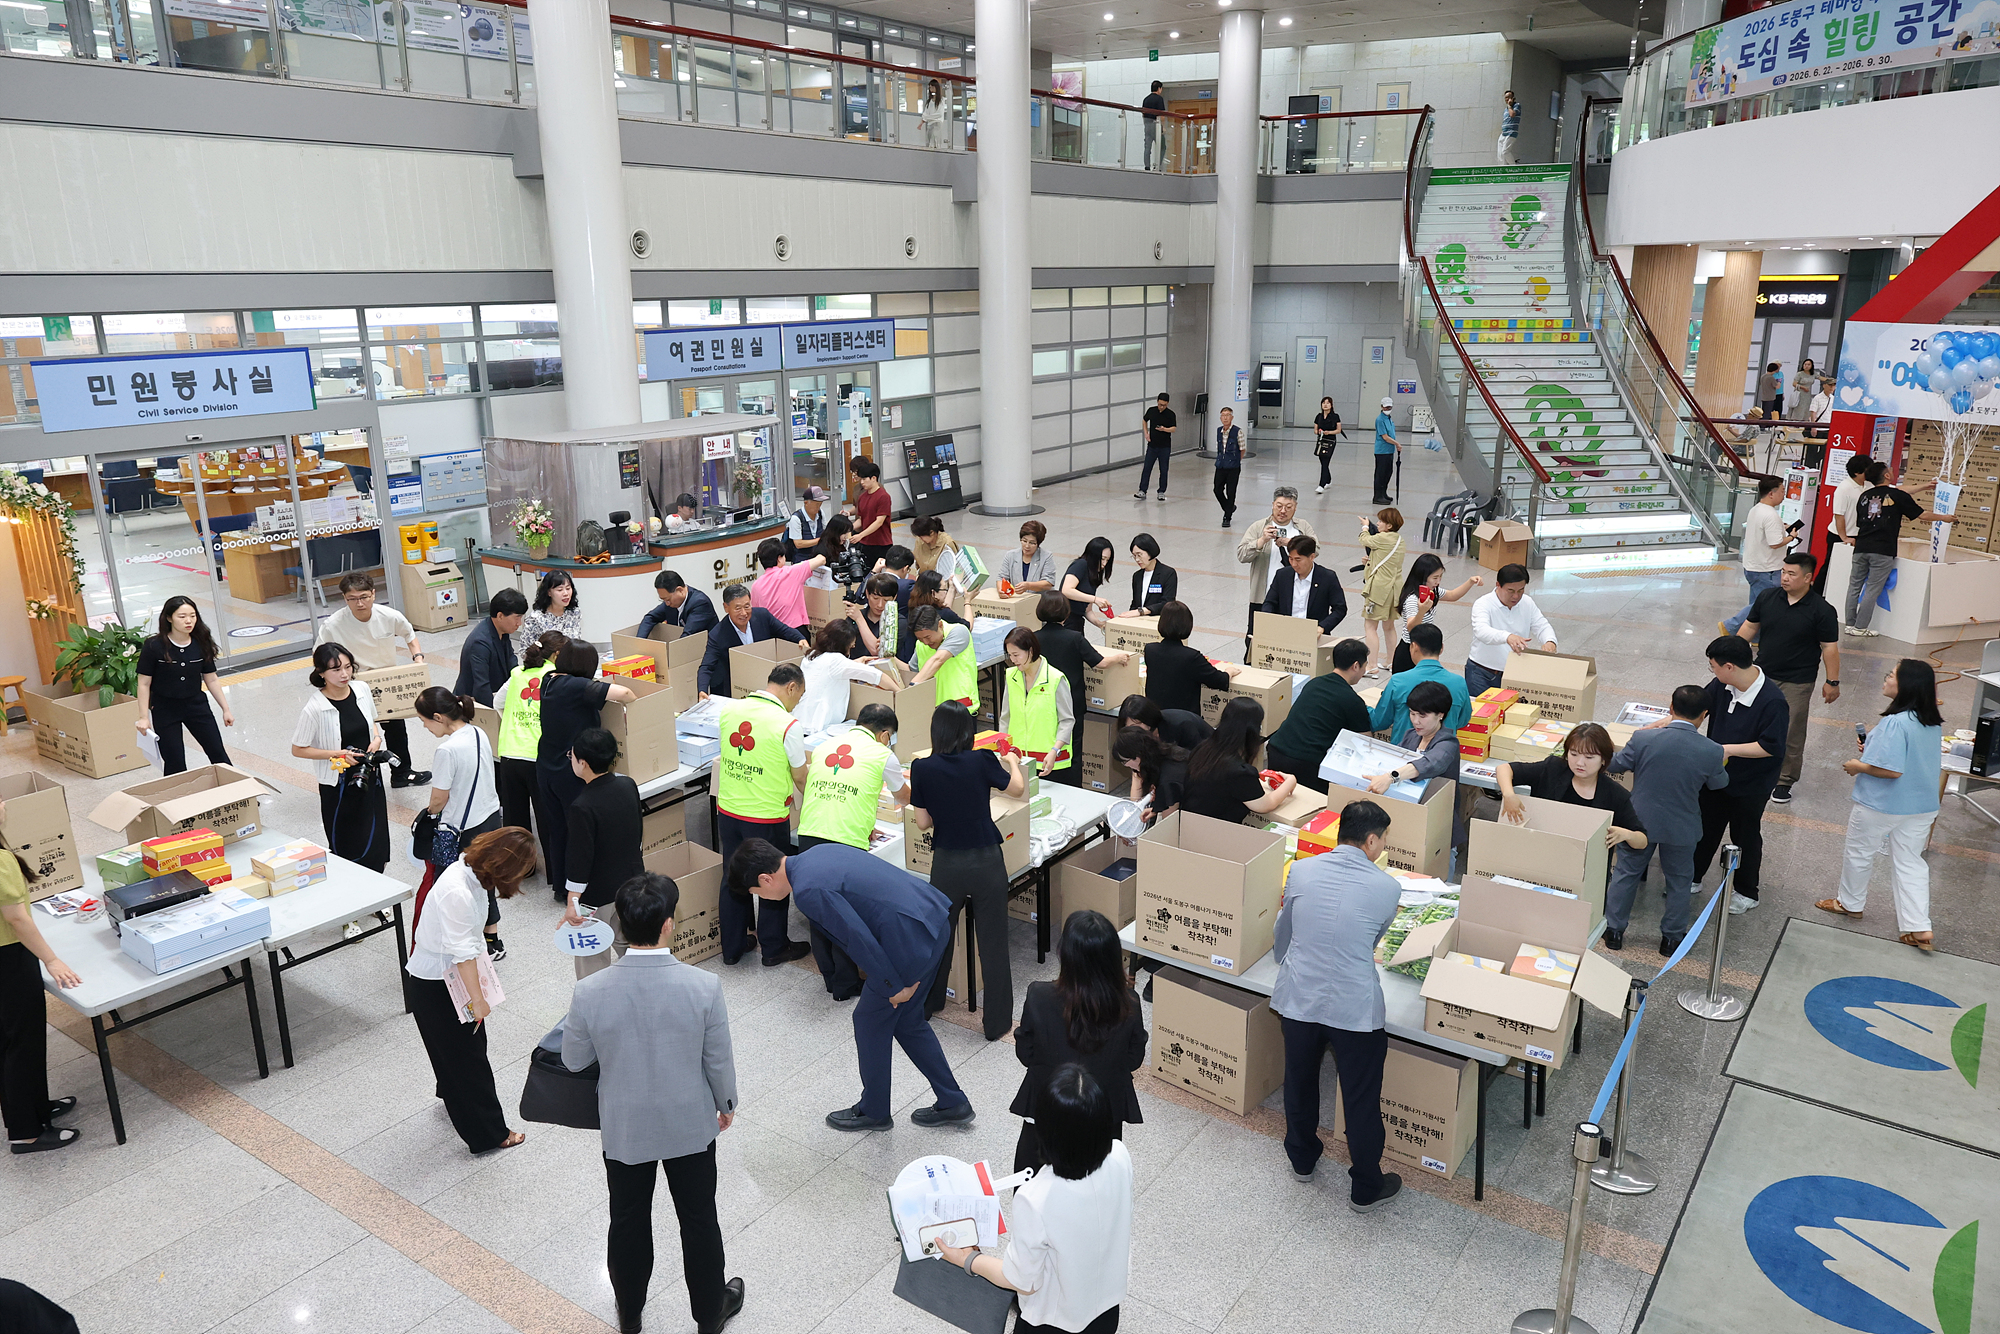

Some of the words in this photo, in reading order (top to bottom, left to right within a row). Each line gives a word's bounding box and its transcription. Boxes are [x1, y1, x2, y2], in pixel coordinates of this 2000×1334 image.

[1744, 14, 1775, 37] 2026
[1778, 5, 1815, 28] 도봉구
[1737, 35, 1780, 74] 도심
[1787, 27, 1811, 64] 속
[1824, 10, 1880, 59] 힐링
[1894, 0, 1965, 45] 공간
[1789, 71, 1811, 82] 2026.
[1813, 70, 1821, 78] 6.
[1867, 58, 1875, 67] 9.
[1878, 55, 1893, 65] 30.
[1769, 294, 1788, 304] KB
[669, 336, 763, 363] 여권민원실
[795, 329, 886, 354] 일자리플러스센터
[842, 354, 856, 362] Support
[691, 364, 713, 374] Passport
[714, 363, 747, 373] Consultations
[87, 365, 274, 407] 민원봉사실
[138, 409, 160, 418] Civil
[163, 406, 199, 416] Service
[202, 402, 239, 413] Division
[1975, 406, 1998, 415] 도봉구
[707, 438, 731, 451] 안내
[1832, 433, 1842, 447] 3
[708, 450, 731, 458] Information
[1824, 494, 1831, 507] 1
[714, 552, 758, 580] 안내
[714, 573, 758, 590] INFORMATION
[1127, 639, 1142, 648] 여름을
[1276, 656, 1291, 665] 여름을
[1293, 659, 1311, 668] 부탁해!
[384, 684, 403, 693] 여름을
[405, 681, 426, 690] 부탁해!
[1086, 676, 1103, 686] 부탁해!
[396, 692, 417, 701] 착착착!
[1530, 699, 1550, 709] 여름을
[1552, 701, 1574, 712] 부탁해!
[1540, 710, 1562, 719] 착착착!
[722, 757, 763, 775] 사랑의열매
[1086, 761, 1104, 770] 부탁해!
[811, 780, 859, 796] 사랑의열매
[198, 808, 221, 821] 여름을
[224, 799, 250, 814] 부탁해!
[212, 814, 239, 828] 착착착!
[1397, 847, 1417, 858] 지원사업
[159, 854, 179, 868] ramen
[167, 862, 178, 871] set
[1387, 859, 1415, 872] 부탁해!
[1475, 869, 1495, 879] 2026년
[1143, 891, 1162, 901] 2026년
[1163, 897, 1173, 905] 서울
[1174, 899, 1189, 909] 도봉구
[1190, 903, 1211, 914] 여름나기
[1212, 909, 1234, 920] 지원사업
[1174, 914, 1201, 930] 여름을
[1202, 921, 1232, 937] 부탁해!
[568, 932, 600, 949] 착!
[1187, 930, 1217, 946] 착착착!
[1496, 1016, 1534, 1035] 착착착!
[1158, 1024, 1175, 1036] 2026년
[1176, 1032, 1185, 1041] 서울
[1186, 1036, 1199, 1046] 도봉구
[1200, 1042, 1218, 1054] 여름나기
[1219, 1050, 1238, 1063] 지원사업
[1186, 1050, 1209, 1067] 여름을
[1211, 1060, 1237, 1079] 부탁해!
[1198, 1066, 1224, 1085] 착착착!
[1380, 1097, 1397, 1108] 도봉구
[1397, 1102, 1421, 1116] 여름나기
[1422, 1111, 1446, 1124] 지원사업
[1381, 1111, 1409, 1130] 여름을
[1411, 1122, 1444, 1141] 부탁해!
[1394, 1129, 1427, 1148] 착착착!
